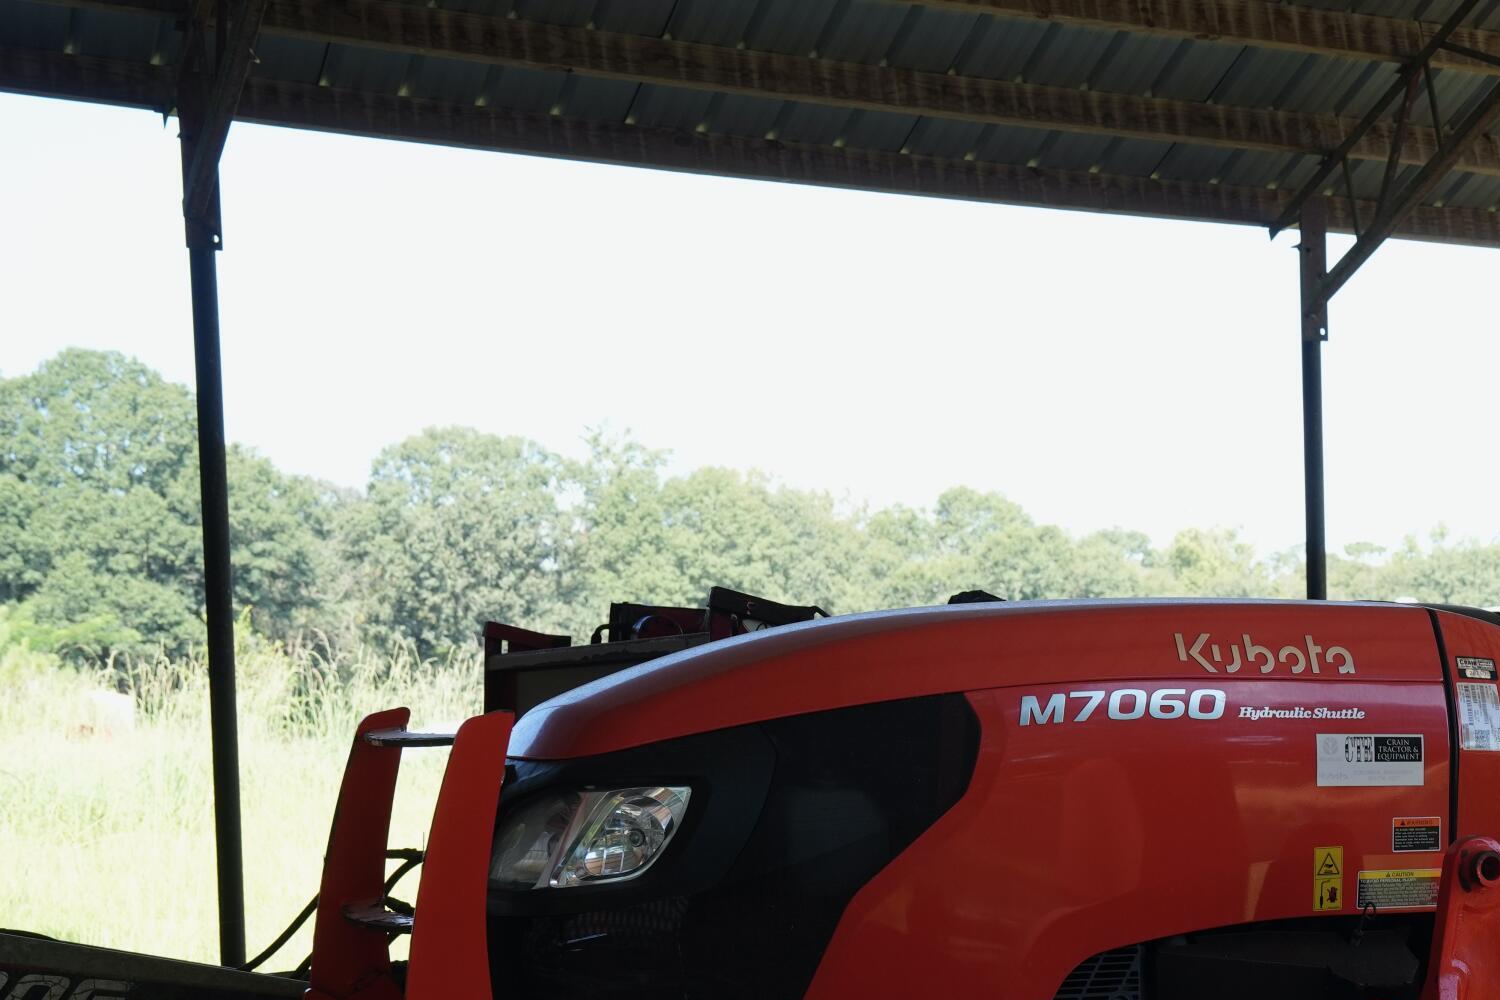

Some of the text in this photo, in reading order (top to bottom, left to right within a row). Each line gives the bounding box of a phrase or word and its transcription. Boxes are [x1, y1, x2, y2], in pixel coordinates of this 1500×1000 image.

[1173, 632, 1356, 674] Kubota
[1019, 688, 1227, 726] M7060
[1238, 706, 1366, 721] Hydraulic Shuttle
[1344, 735, 1374, 762] CTE
[1386, 738, 1410, 746] CRAIN
[1377, 753, 1419, 761] EQUIPMENT
